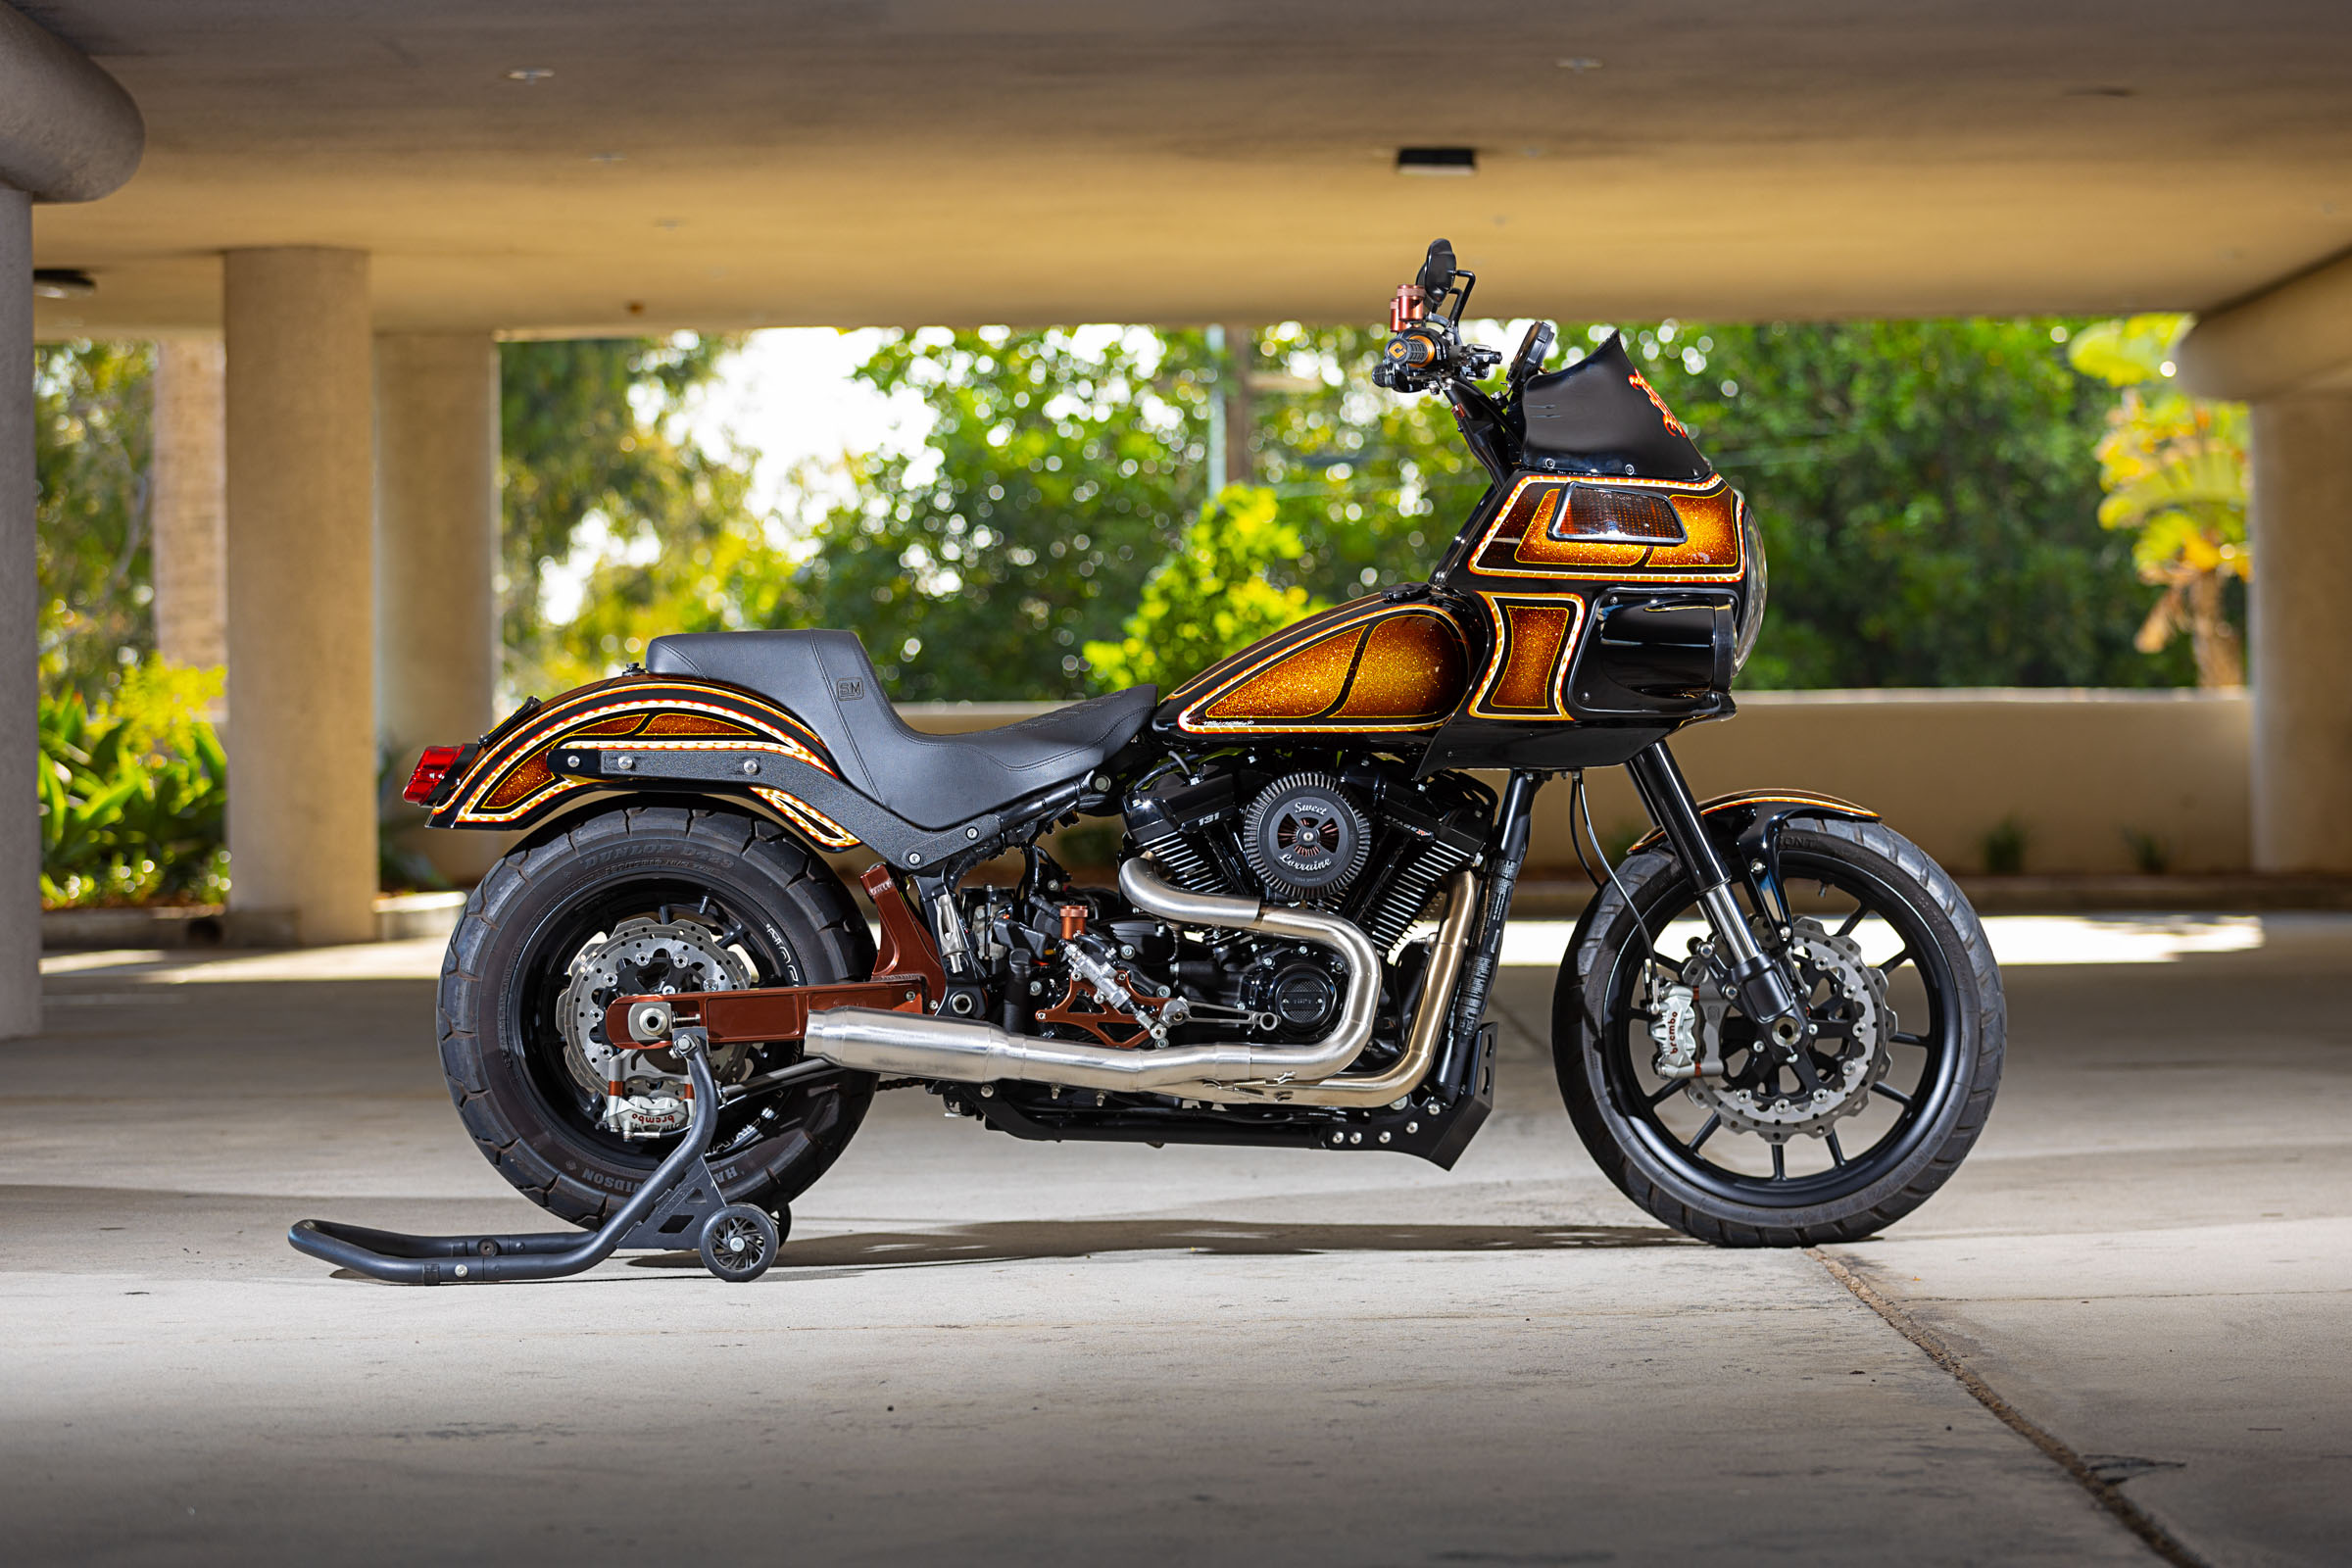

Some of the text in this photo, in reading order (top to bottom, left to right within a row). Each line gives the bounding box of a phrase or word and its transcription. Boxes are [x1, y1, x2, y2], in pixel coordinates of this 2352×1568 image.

[1295, 802, 1328, 815] Sweet
[1198, 811, 1220, 826] 131
[584, 842, 674, 870] DUNLOP
[1279, 853, 1332, 871] Lorraine
[1667, 1010, 1679, 1055] brembo
[631, 1112, 675, 1125] brembo
